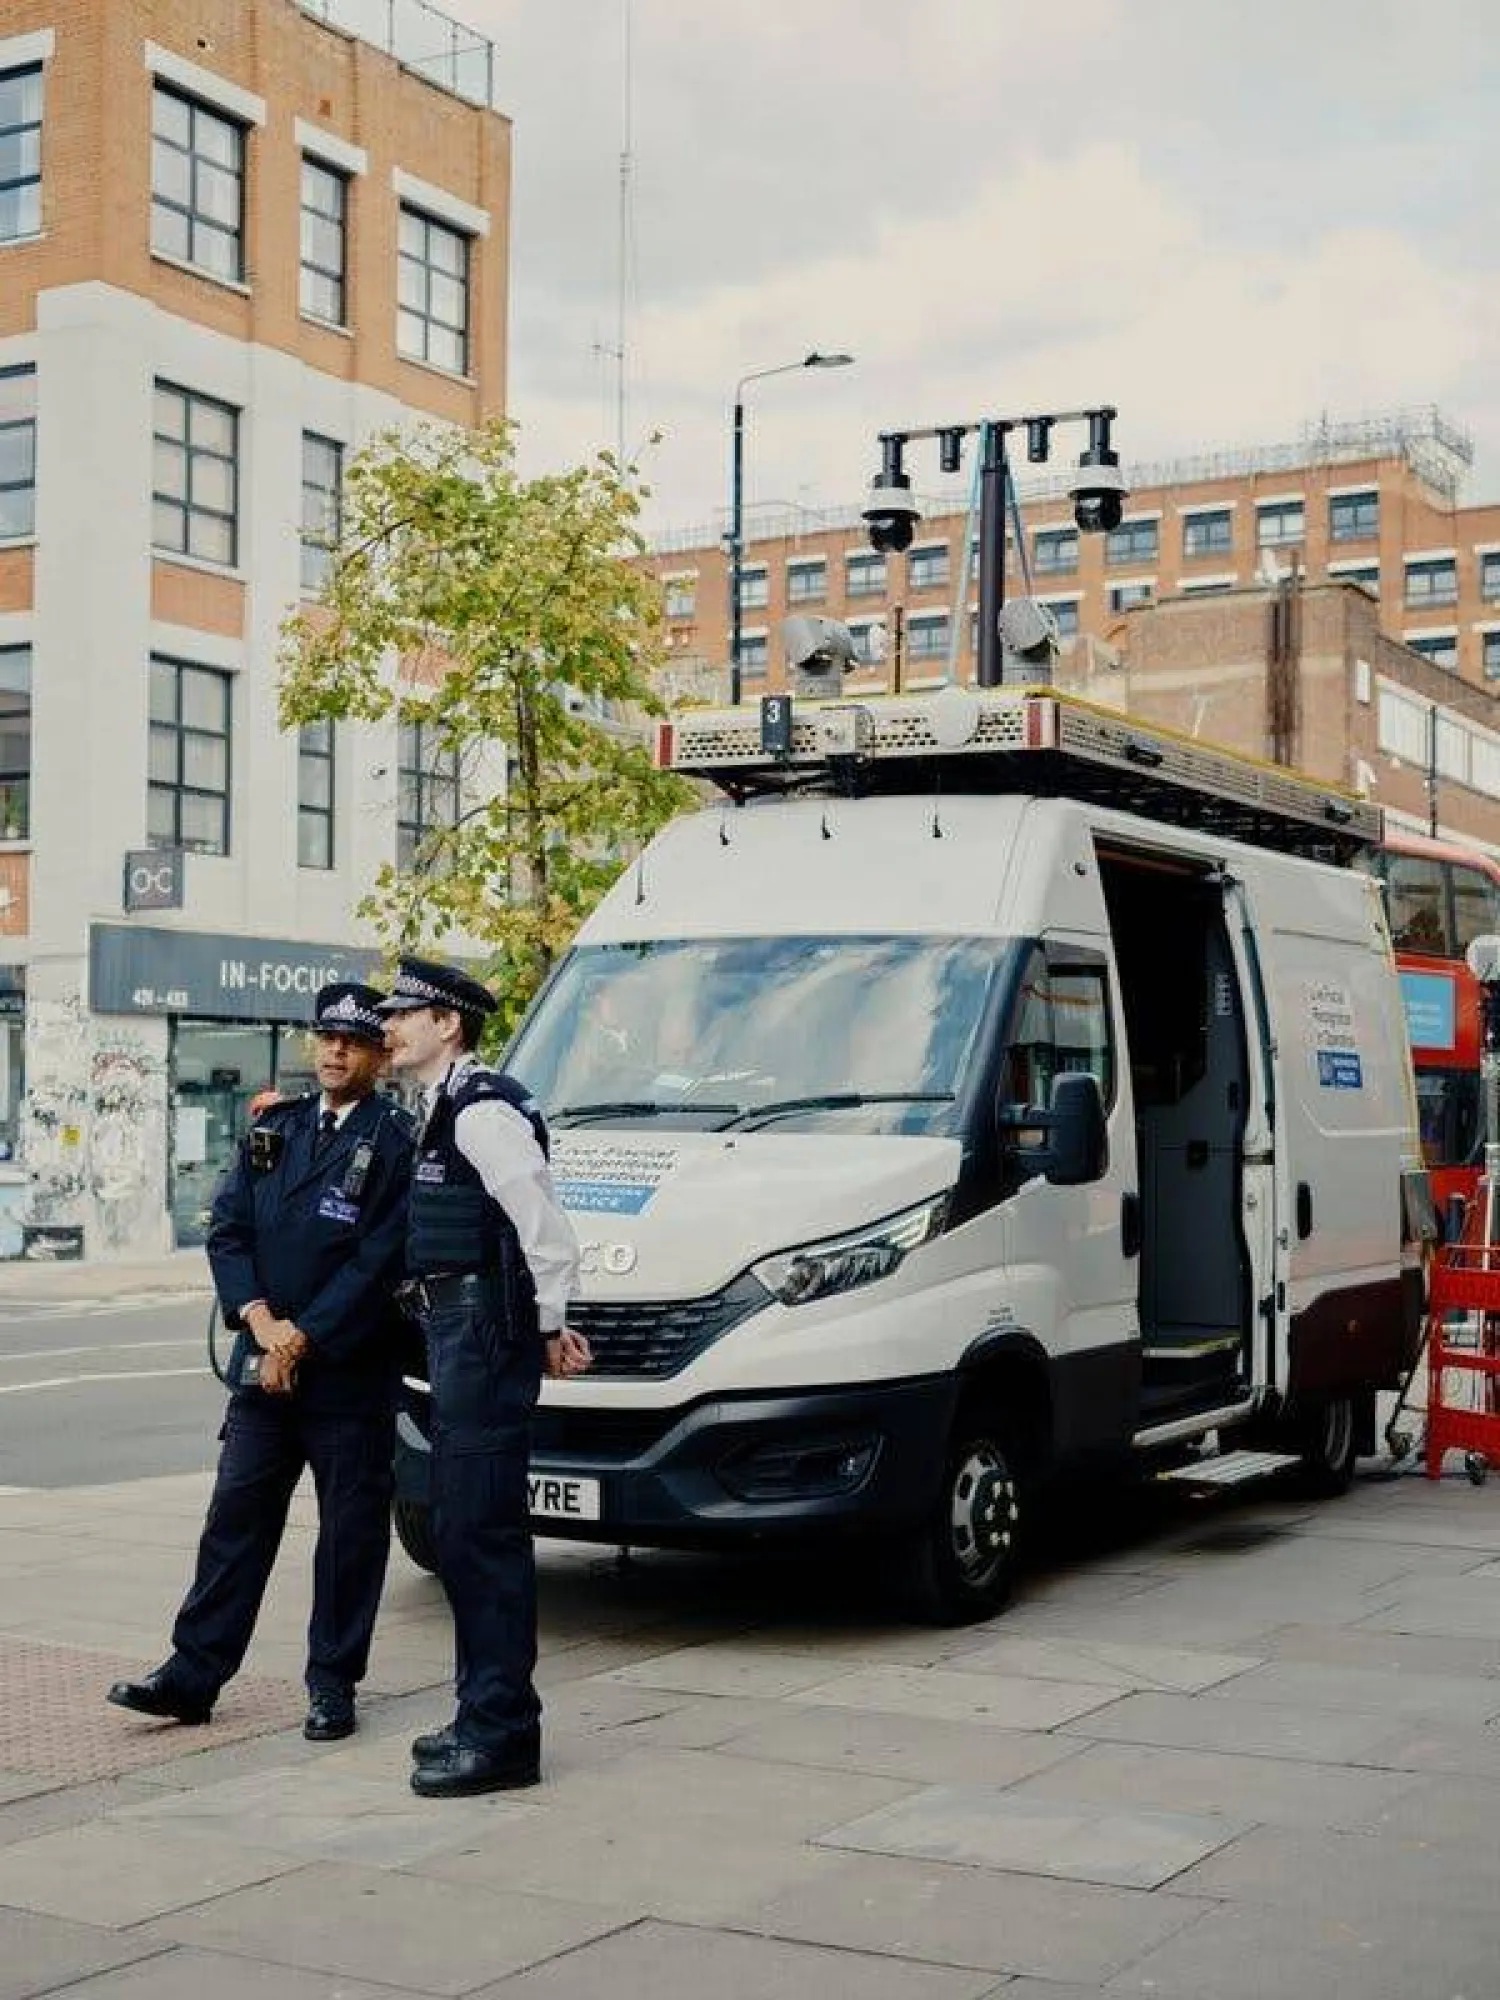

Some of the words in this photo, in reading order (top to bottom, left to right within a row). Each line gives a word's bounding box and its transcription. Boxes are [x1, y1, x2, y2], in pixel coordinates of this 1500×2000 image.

[767, 700, 780, 723] 3
[219, 959, 340, 994] IN-FOCUS
[529, 1479, 581, 1513] YRE
